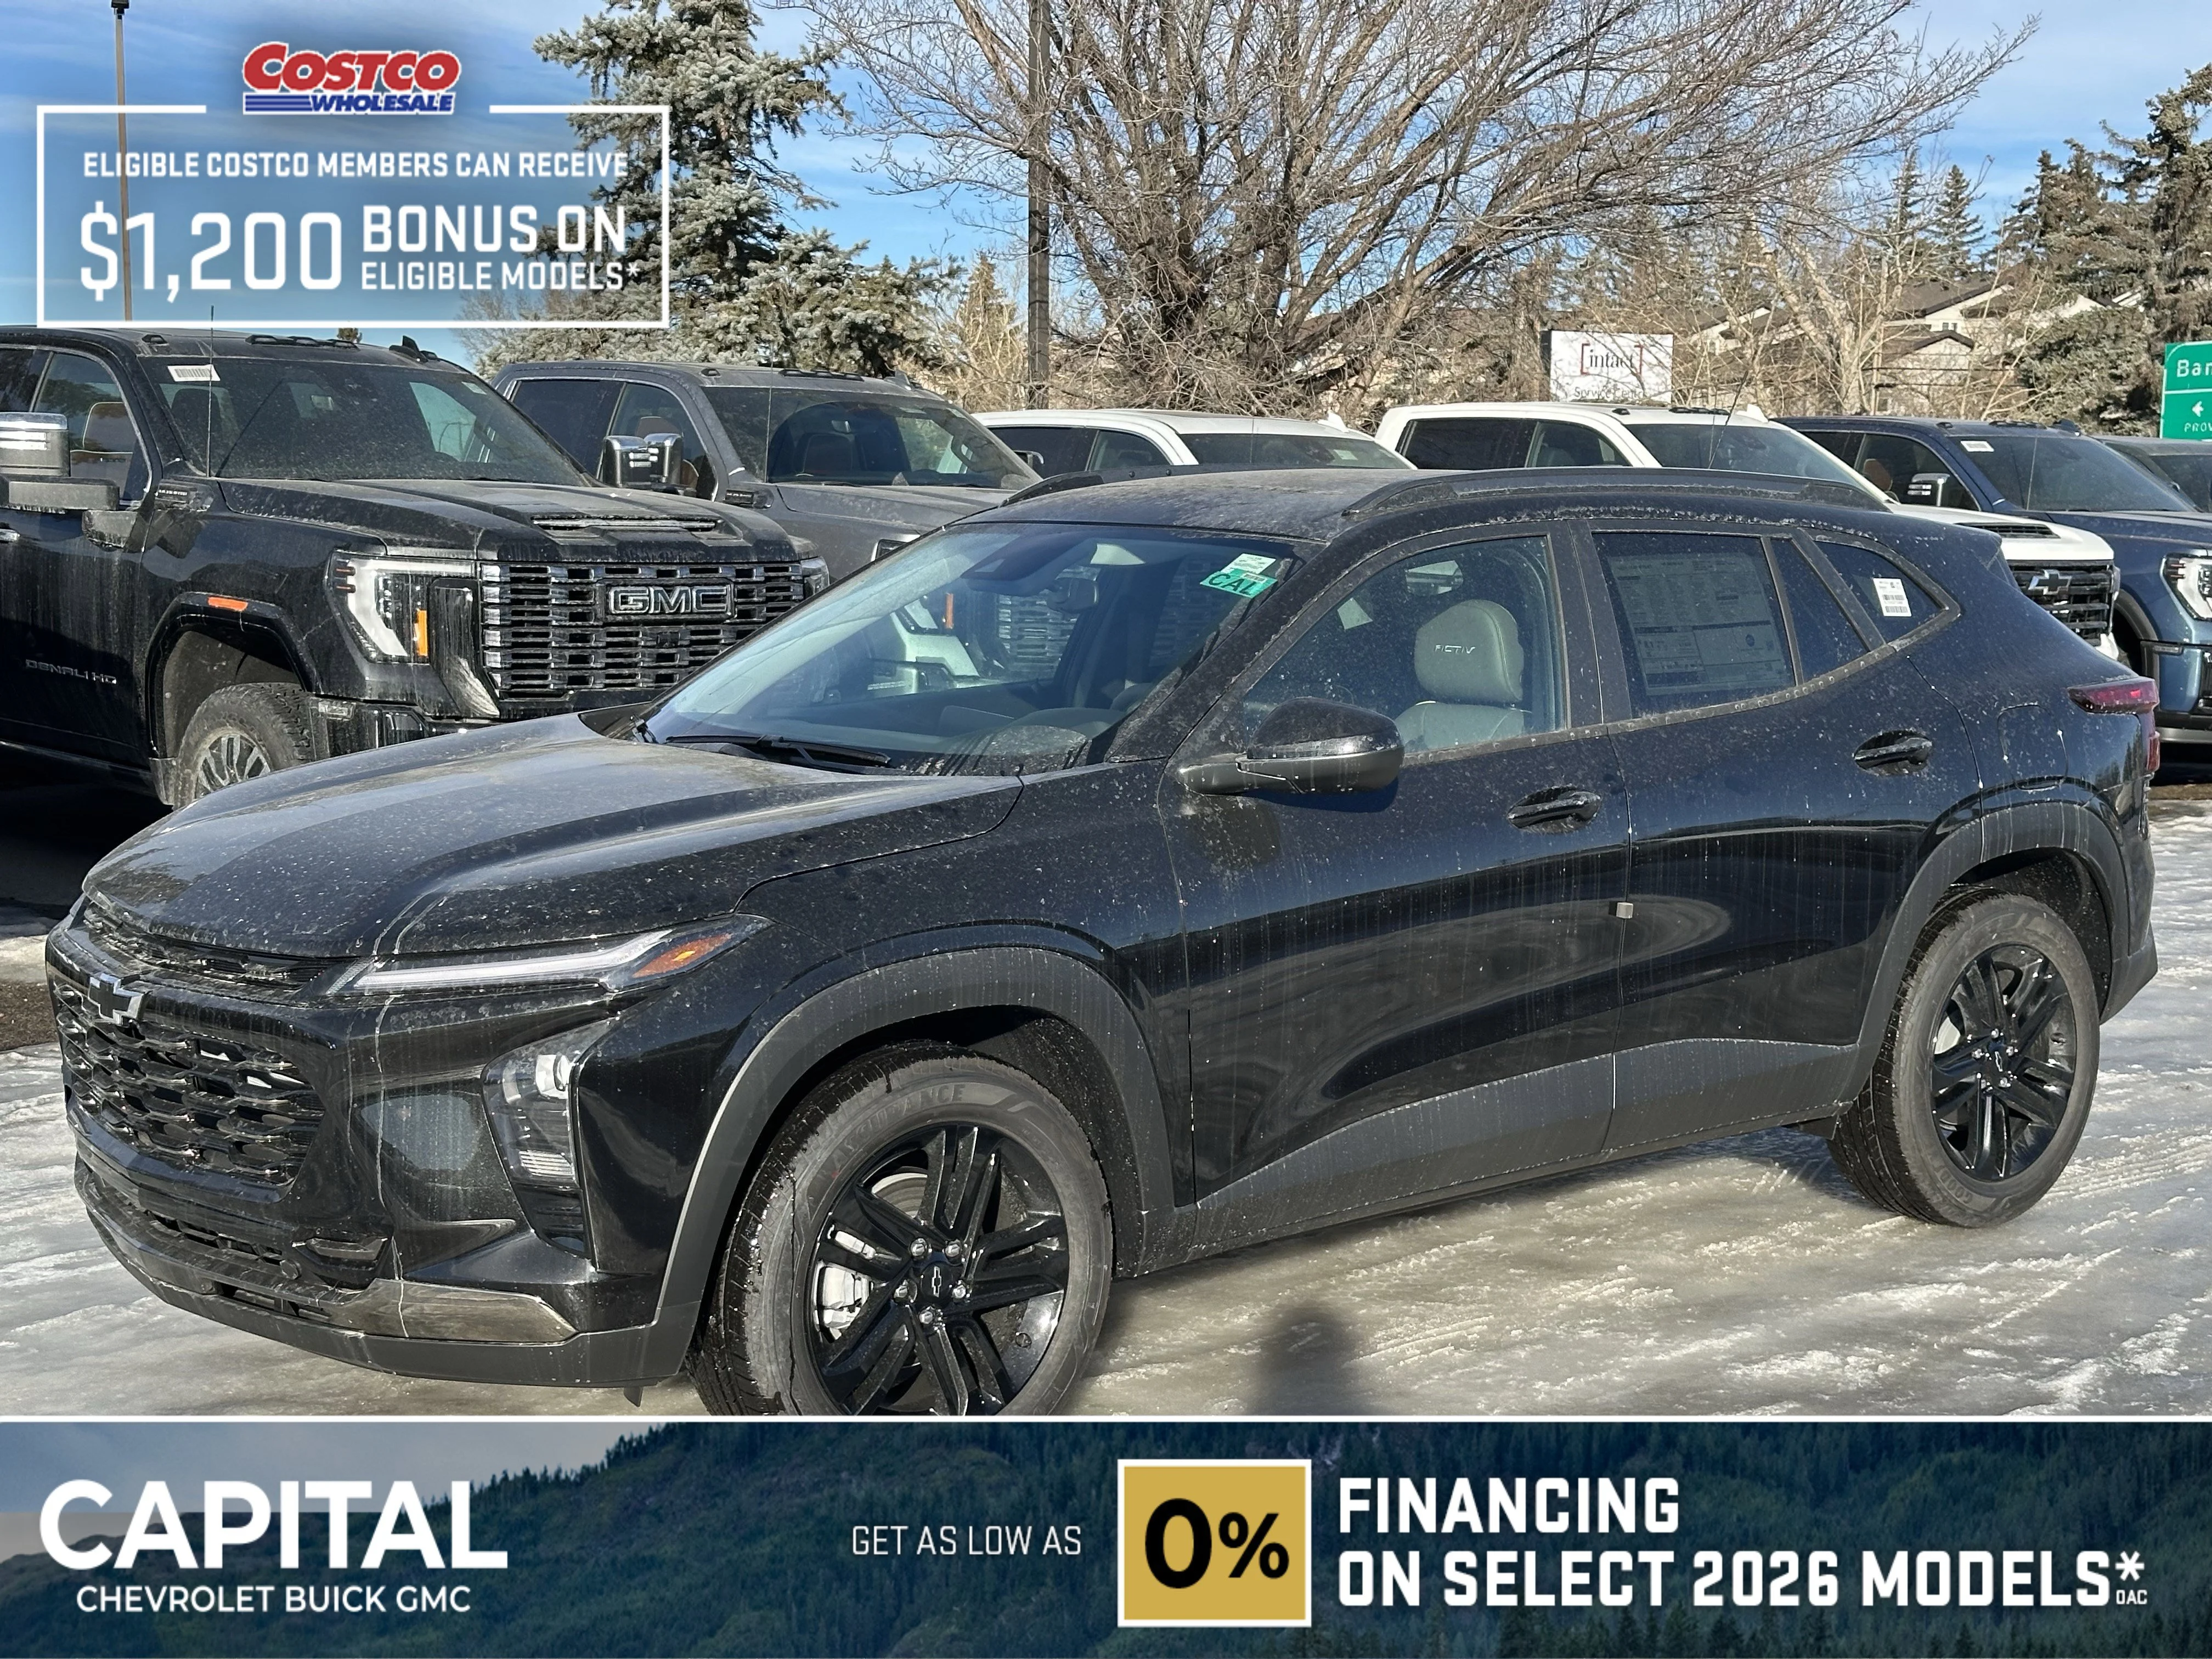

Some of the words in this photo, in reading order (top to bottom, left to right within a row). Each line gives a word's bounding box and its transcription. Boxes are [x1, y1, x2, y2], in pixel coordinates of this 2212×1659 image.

[1209, 573, 1256, 596] CAL
[609, 586, 727, 614] GMC
[25, 659, 88, 680] DENALI
[92, 672, 117, 684] HD
